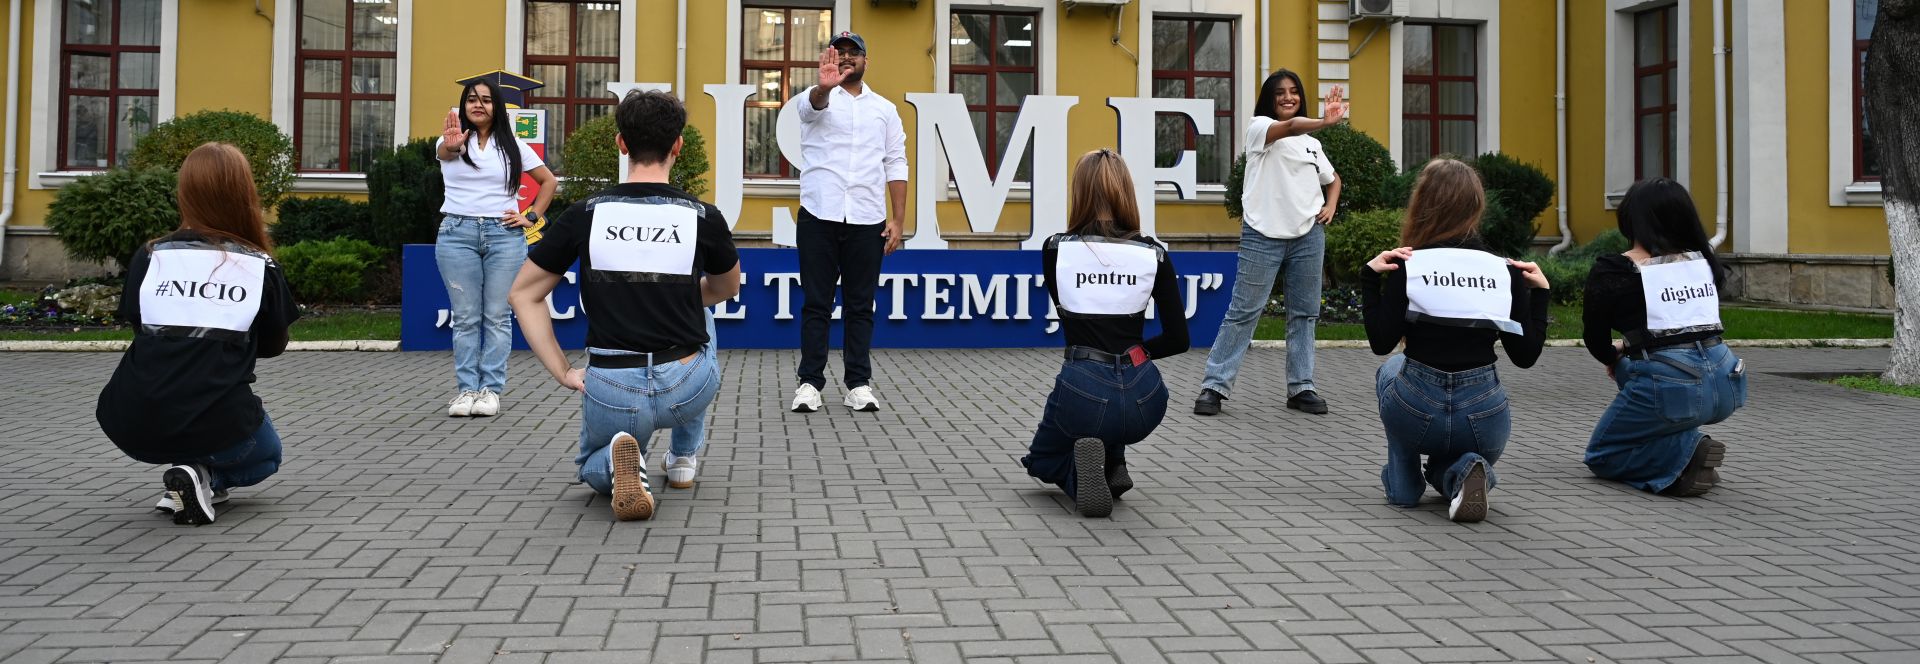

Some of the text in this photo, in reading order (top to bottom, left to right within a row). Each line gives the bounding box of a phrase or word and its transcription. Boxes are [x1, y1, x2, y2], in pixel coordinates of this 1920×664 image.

[607, 82, 1214, 252] UMF
[605, 224, 682, 244] SCUZĂ
[1076, 270, 1137, 289] pentru
[1422, 270, 1497, 292] violența
[155, 280, 247, 303] #NICIO
